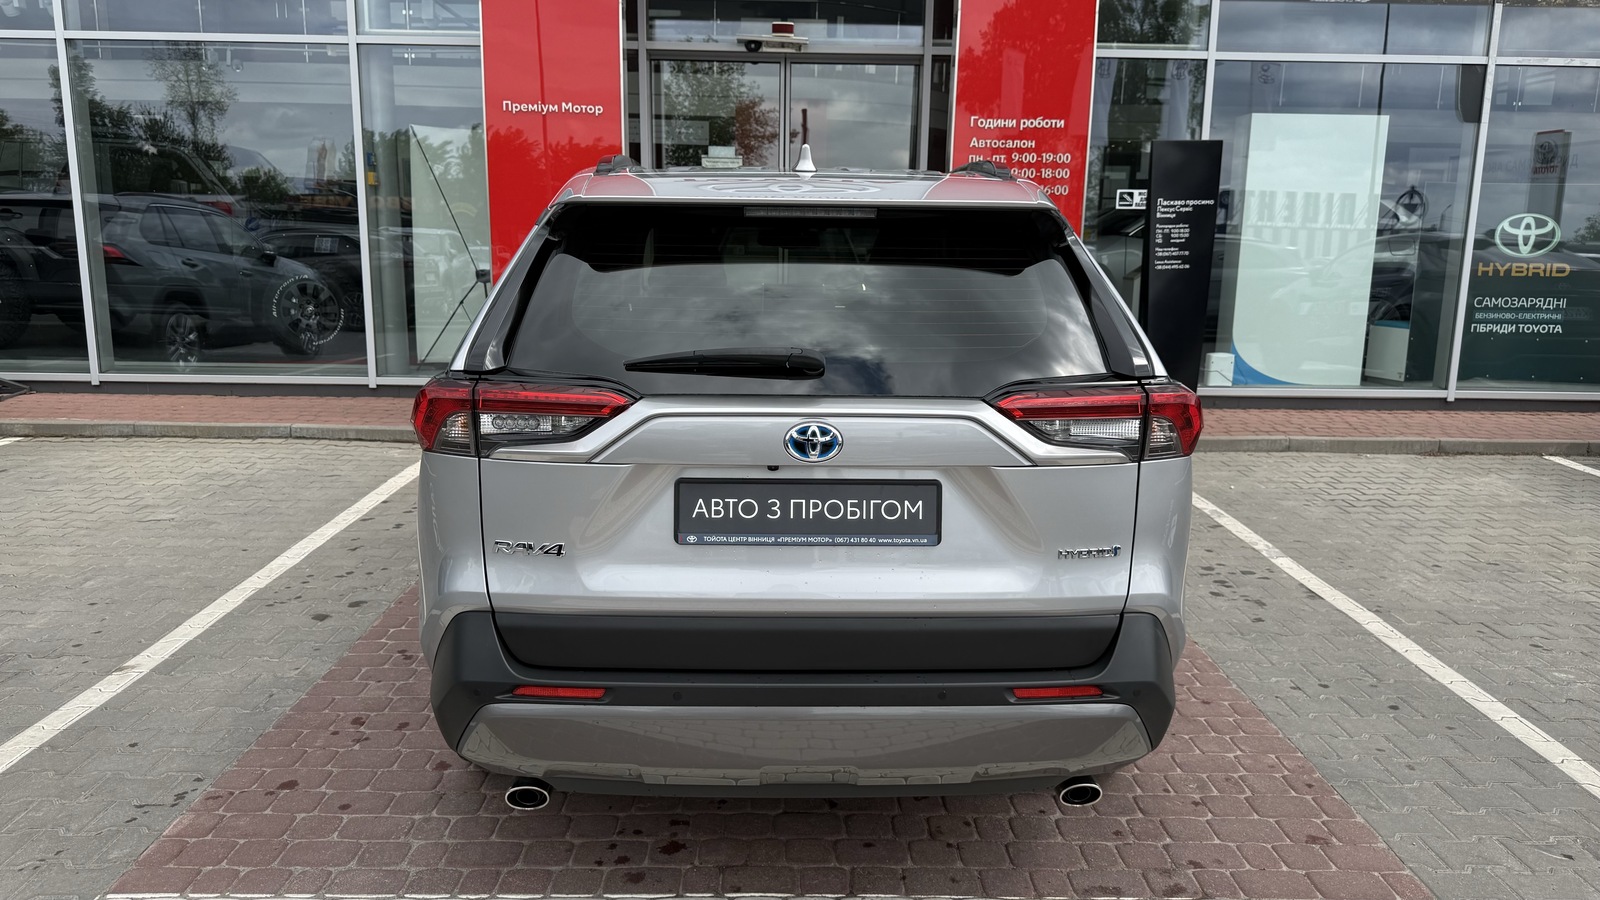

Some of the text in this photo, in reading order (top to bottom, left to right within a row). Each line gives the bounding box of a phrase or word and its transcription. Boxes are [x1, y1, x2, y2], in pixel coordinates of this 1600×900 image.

[503, 100, 603, 116] Преміум Мотор
[970, 116, 1065, 130] Години роботи
[969, 137, 1035, 148] Автосалон
[1011, 152, 1071, 164] 9:00-19:00
[1477, 262, 1571, 277] HYBRID
[1474, 296, 1567, 310] САМОЗАРЯДНІ
[1474, 312, 1562, 320] БЕНЗИНОВО-ЕЛЕКТРИЧНІ
[1470, 323, 1563, 334] ГІБРИДИ TOYOTA
[692, 498, 759, 519] АВТО
[790, 499, 924, 520] ПРОБІГОМ
[703, 535, 728, 543] ТОЙОТА
[748, 536, 775, 544] ВІННИЦЯ
[834, 536, 850, 544] (067)
[878, 537, 928, 545] www.toyota.vn.ua
[493, 539, 566, 558] RAV4
[1057, 547, 1114, 560] HYBRID
